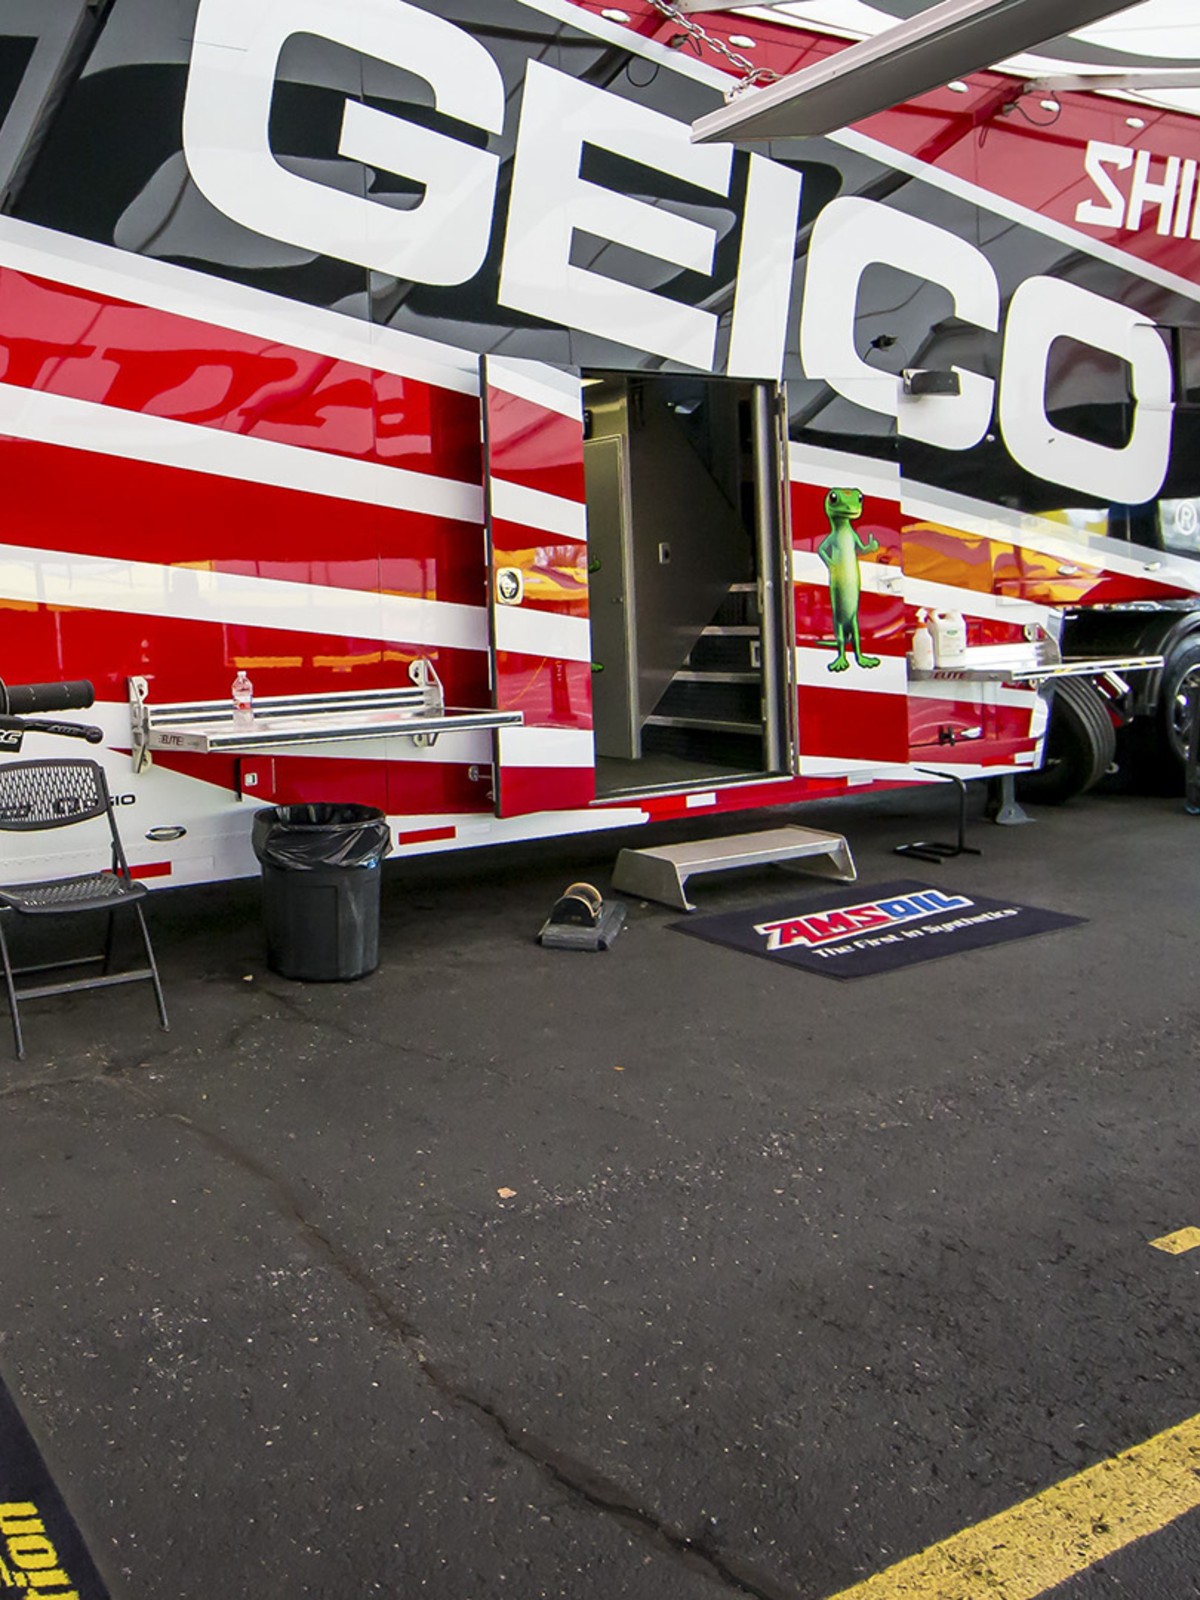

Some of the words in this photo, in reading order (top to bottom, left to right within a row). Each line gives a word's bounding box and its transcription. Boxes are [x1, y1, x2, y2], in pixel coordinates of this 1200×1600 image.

[1075, 139, 1200, 241] SHI
[182, 0, 1173, 504] GEICO
[760, 890, 970, 947] AMSOIL
[811, 944, 856, 959] The
[853, 934, 903, 951] First
[904, 928, 924, 941] in
[921, 908, 1020, 936] Synthetics
